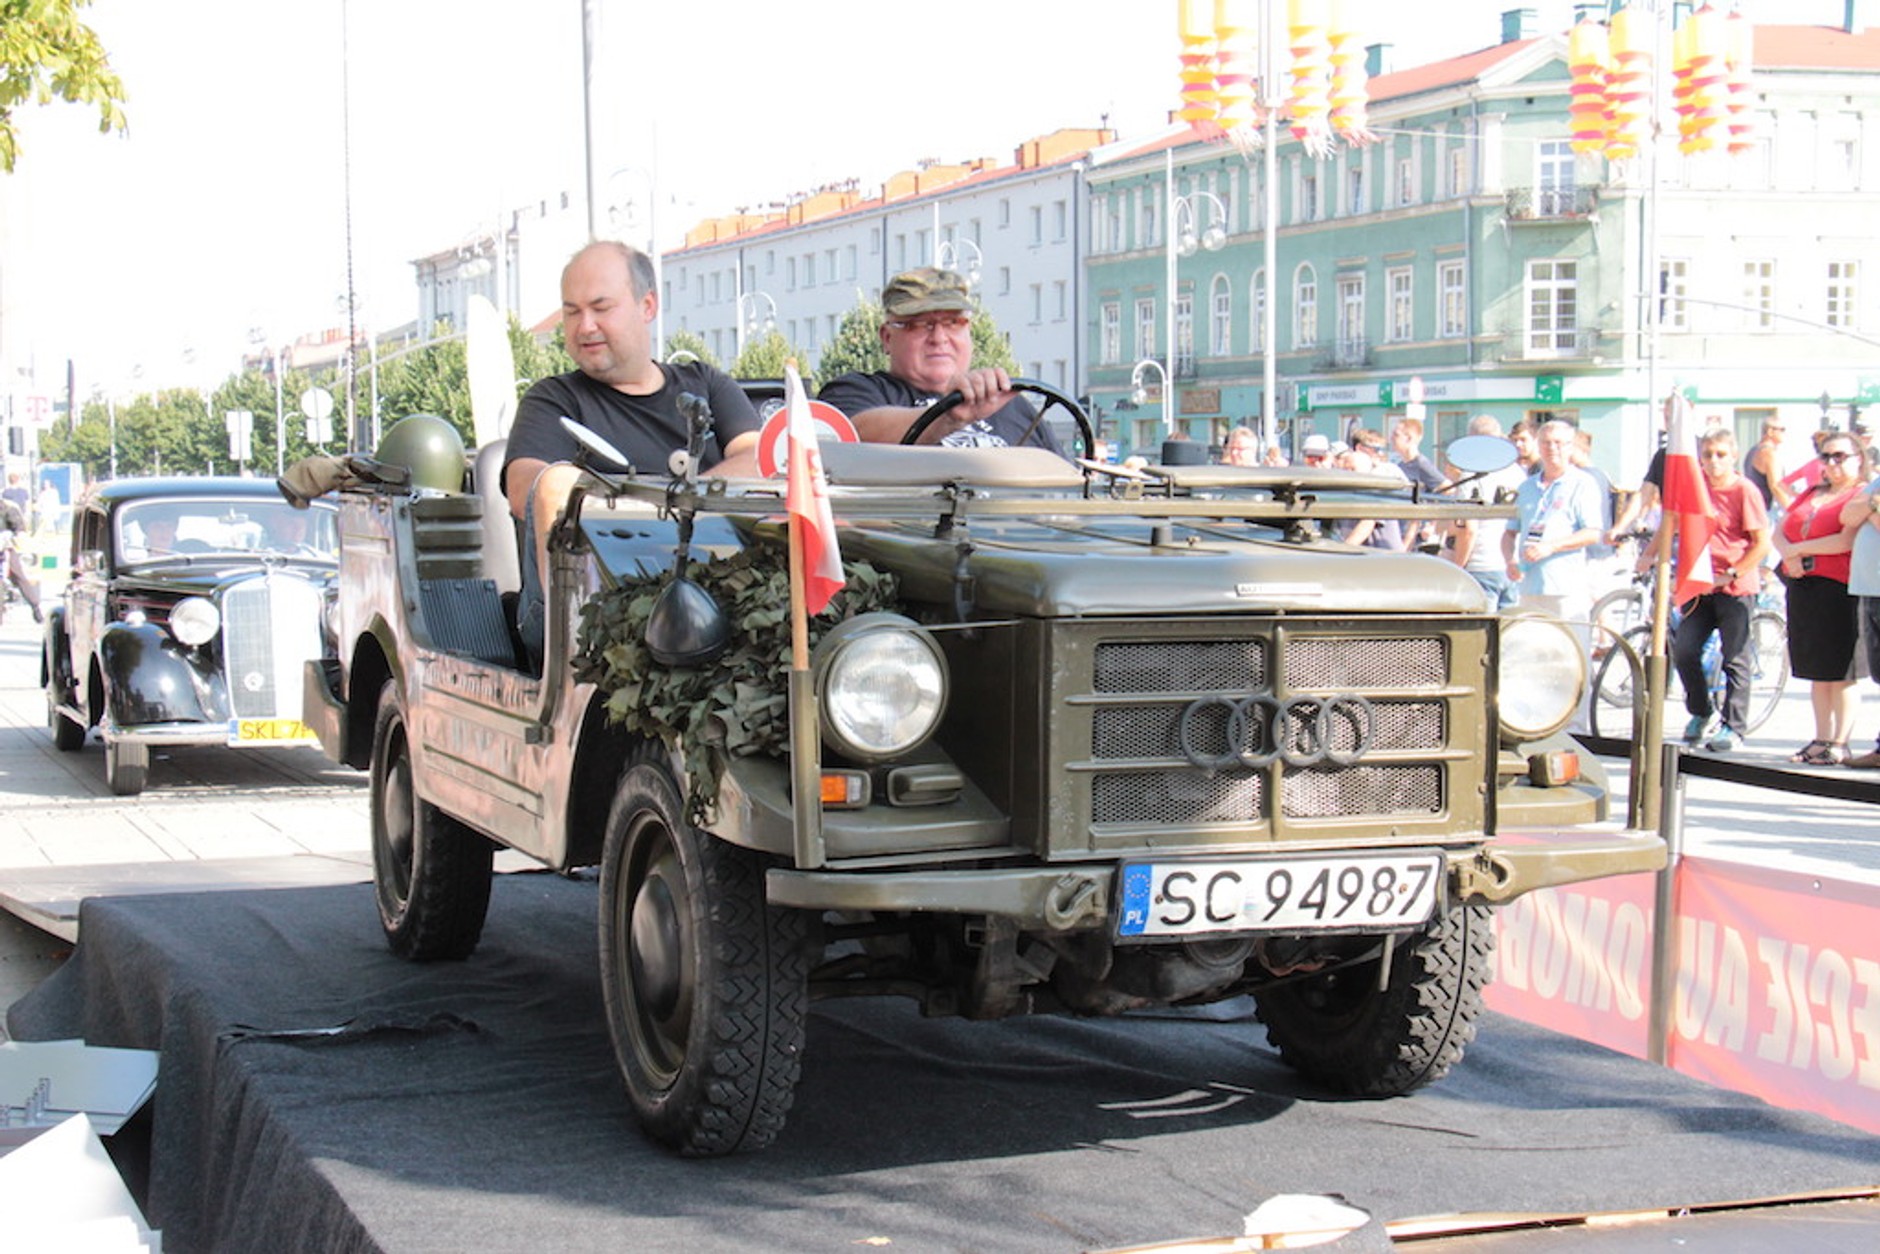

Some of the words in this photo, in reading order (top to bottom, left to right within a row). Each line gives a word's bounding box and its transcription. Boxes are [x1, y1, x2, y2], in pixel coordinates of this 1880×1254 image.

[241, 721, 281, 740] SKL
[1160, 870, 1243, 926] SC
[1263, 864, 1433, 922] 94987
[1125, 910, 1145, 925] PL
